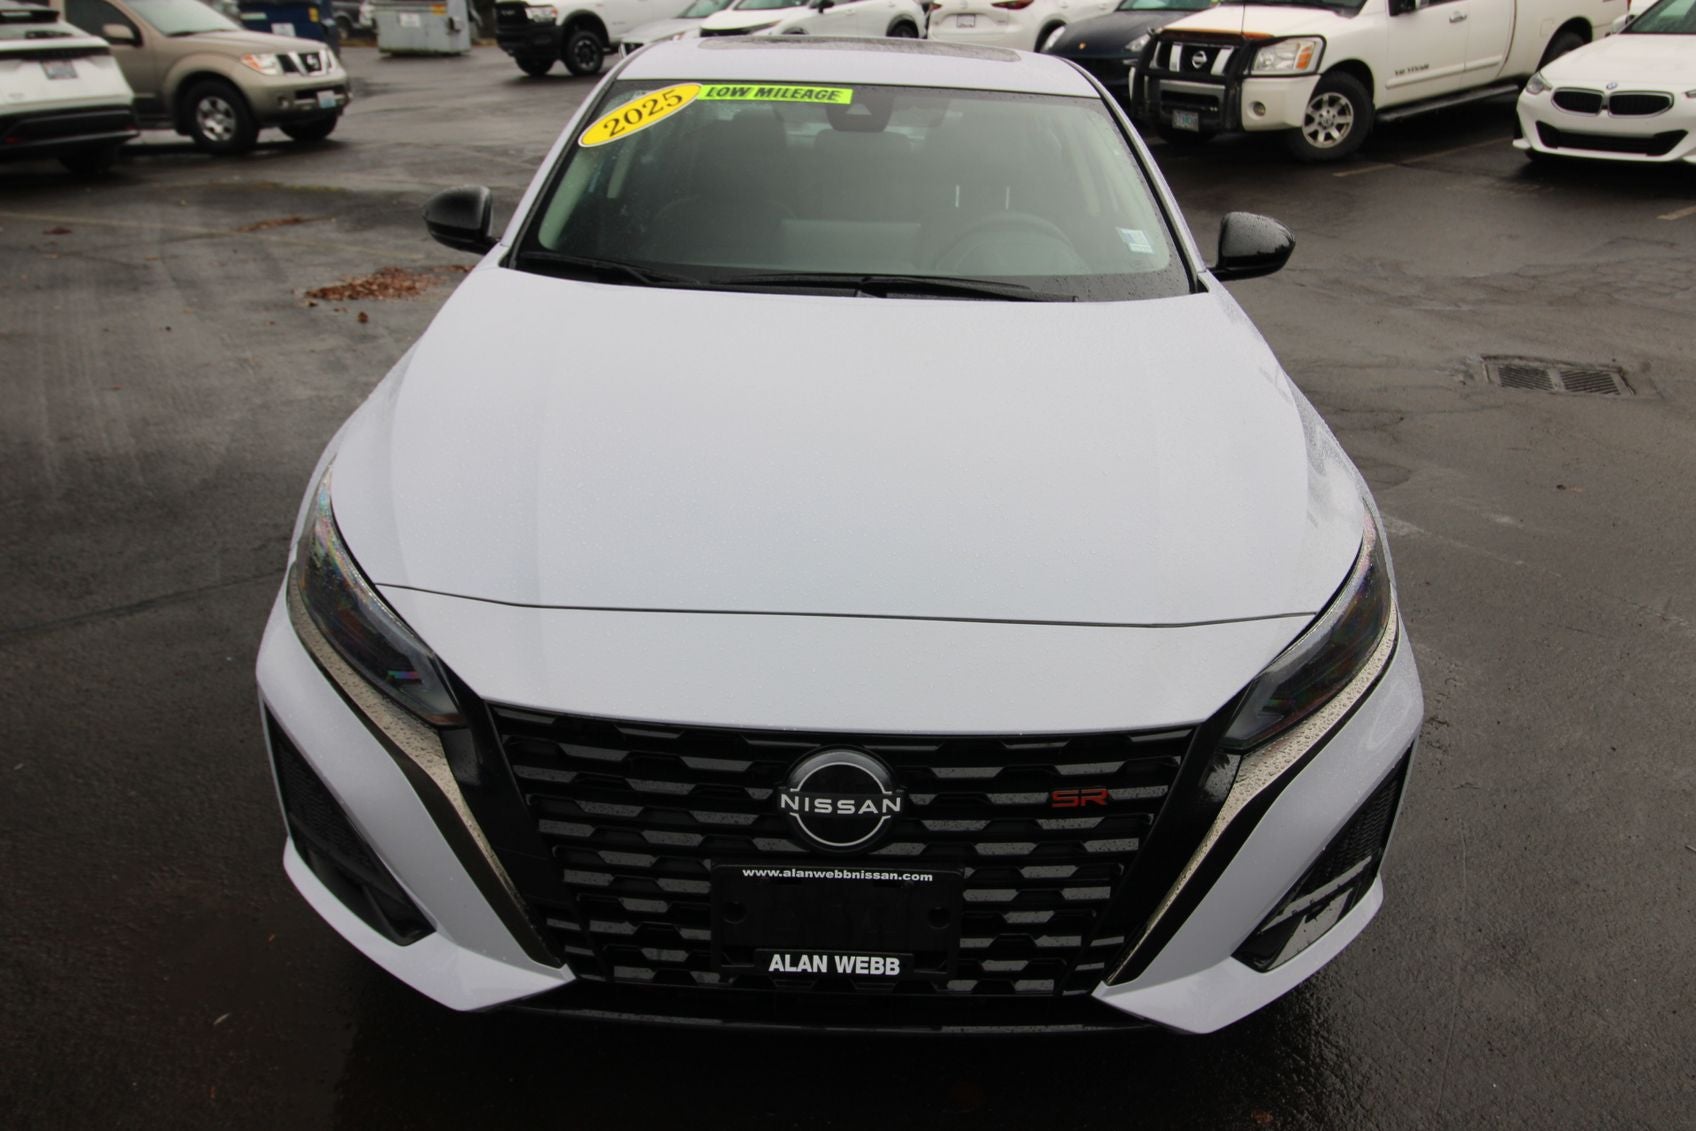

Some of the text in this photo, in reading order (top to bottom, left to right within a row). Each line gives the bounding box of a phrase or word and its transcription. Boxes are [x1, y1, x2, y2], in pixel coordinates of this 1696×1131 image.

[706, 86, 840, 102] LOW MILEAGE
[602, 89, 684, 137] 2025
[780, 793, 901, 816] NISSAN
[1051, 788, 1109, 808] SR
[742, 868, 933, 882] www.alanwebbnissan.com
[768, 953, 901, 976] ALAN WEBB
